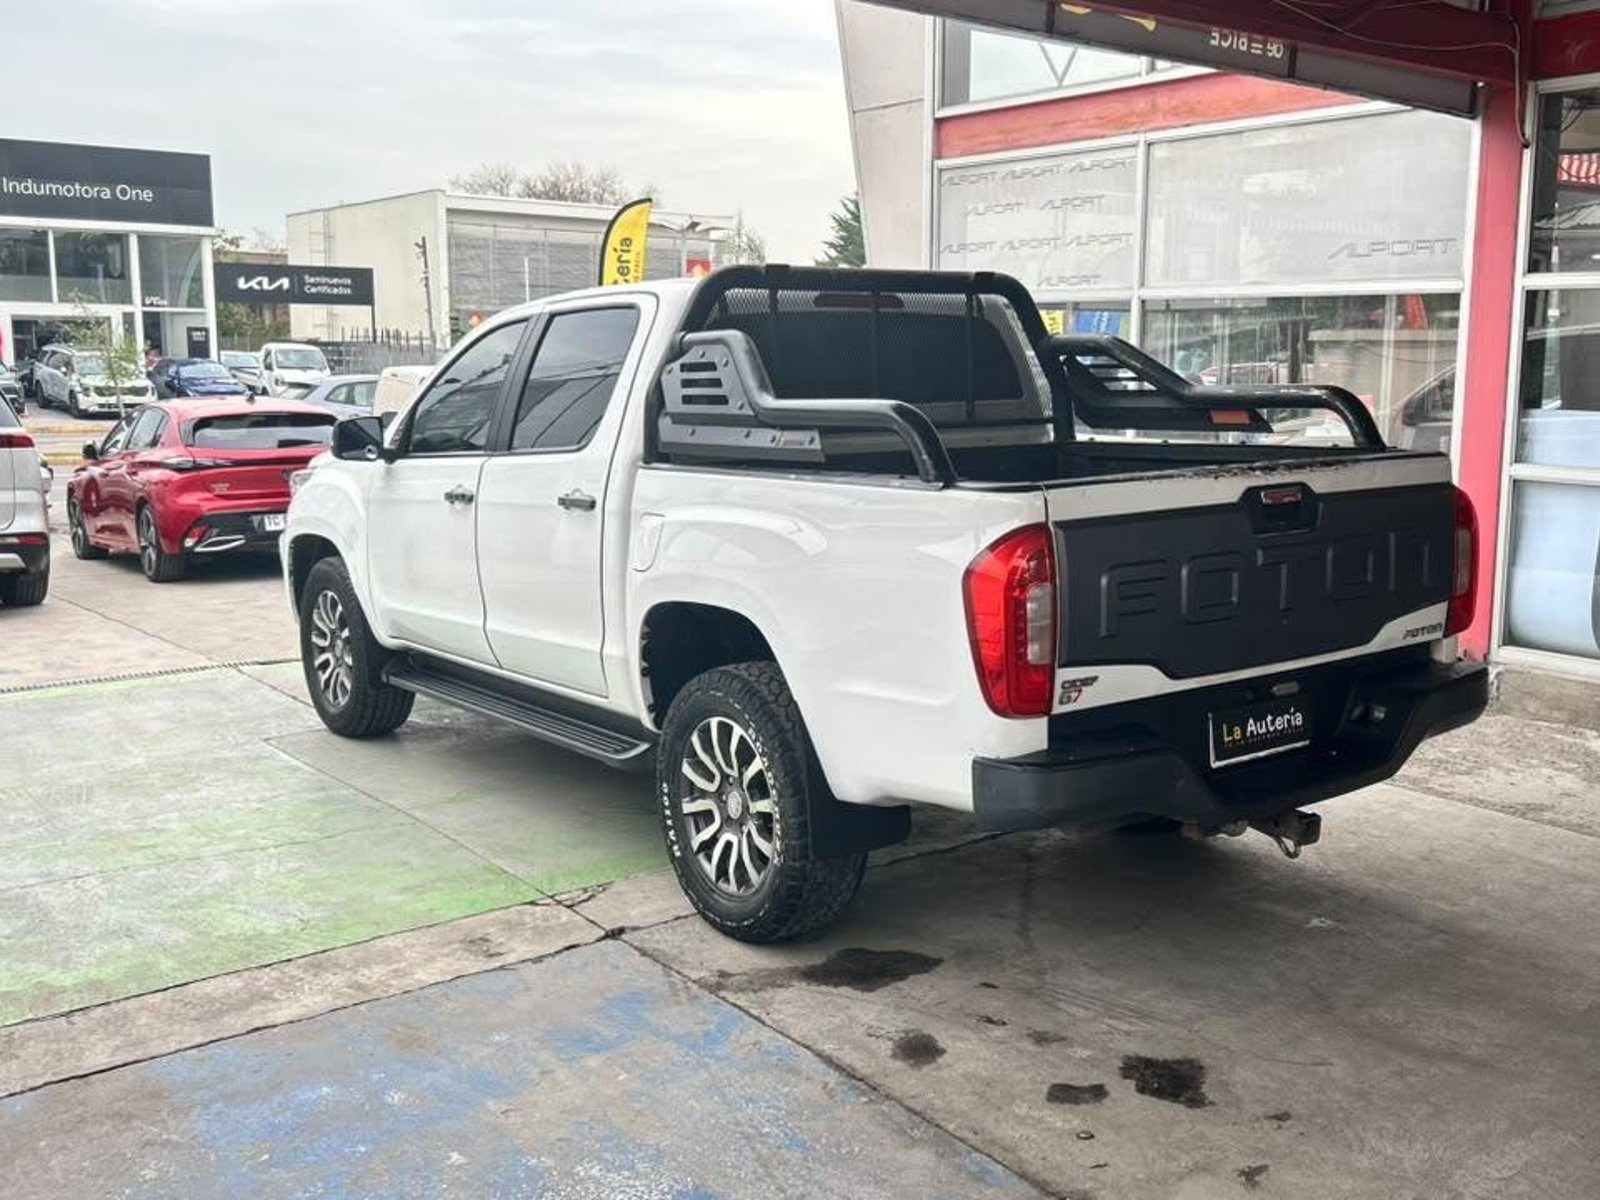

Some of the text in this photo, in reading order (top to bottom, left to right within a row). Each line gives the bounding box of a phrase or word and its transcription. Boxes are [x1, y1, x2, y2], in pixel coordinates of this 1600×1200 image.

[2, 176, 154, 202] Indumotora One
[612, 237, 633, 285] ería
[1328, 238, 1456, 259] ALPORT
[304, 284, 351, 294] Certificados
[1099, 532, 1437, 639] FOTON
[1223, 723, 1241, 742] La
[1246, 706, 1303, 737] Autería
